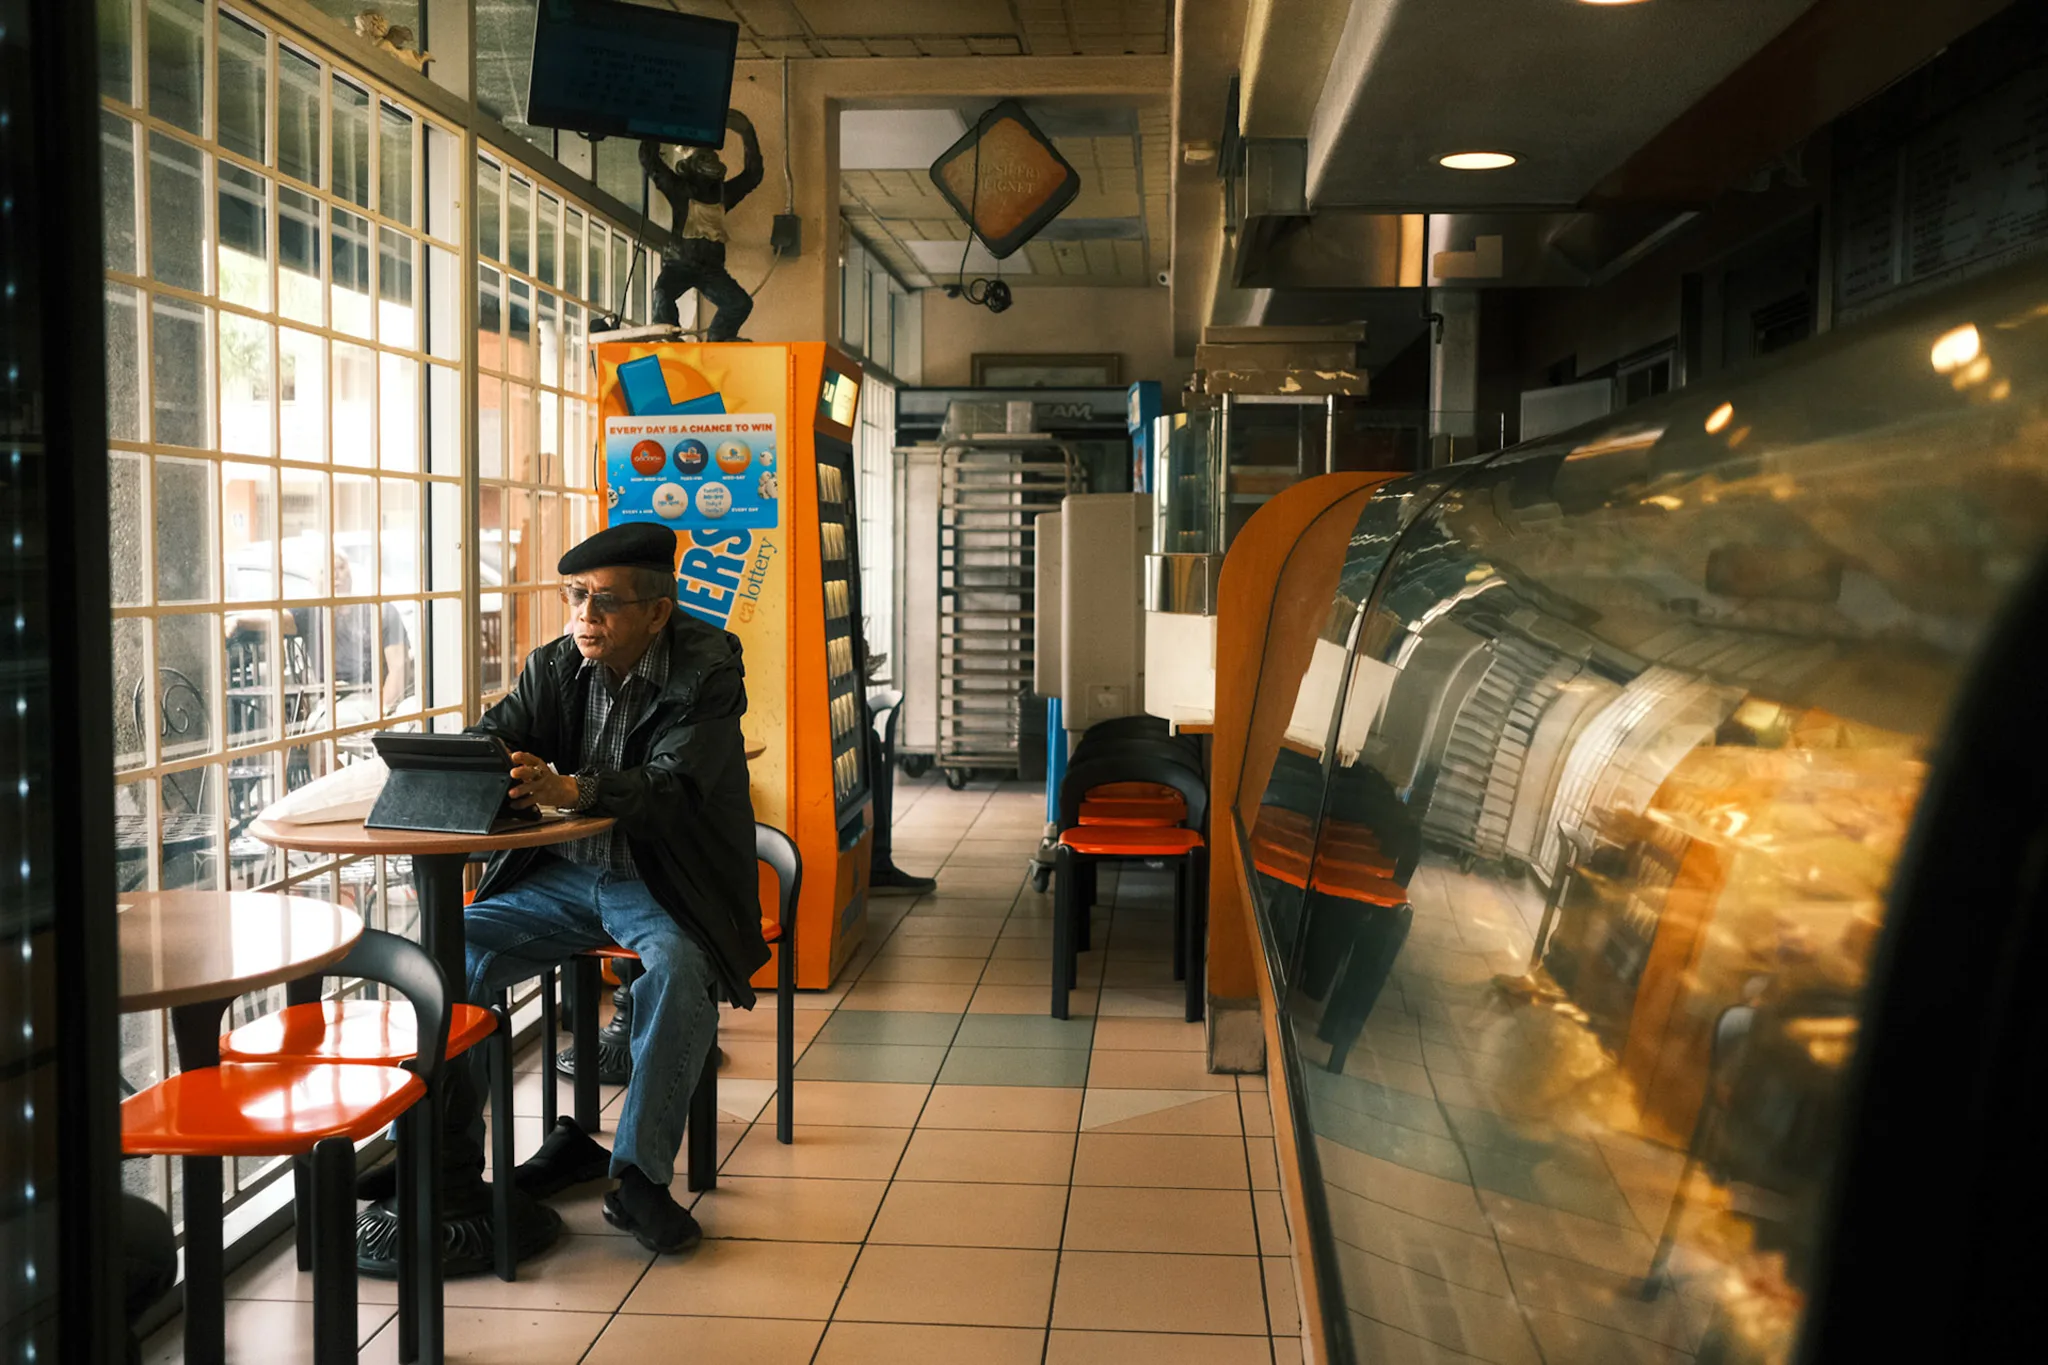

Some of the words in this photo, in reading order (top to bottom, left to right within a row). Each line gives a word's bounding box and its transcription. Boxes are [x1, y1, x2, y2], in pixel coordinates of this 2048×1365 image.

[609, 426, 643, 435] EVERY
[646, 425, 666, 434] DAY
[669, 425, 678, 434] IS
[680, 425, 689, 433] A
[689, 424, 732, 433] CHANCE
[735, 423, 749, 432] TO
[751, 423, 773, 432] WIN
[677, 528, 752, 629] ERS
